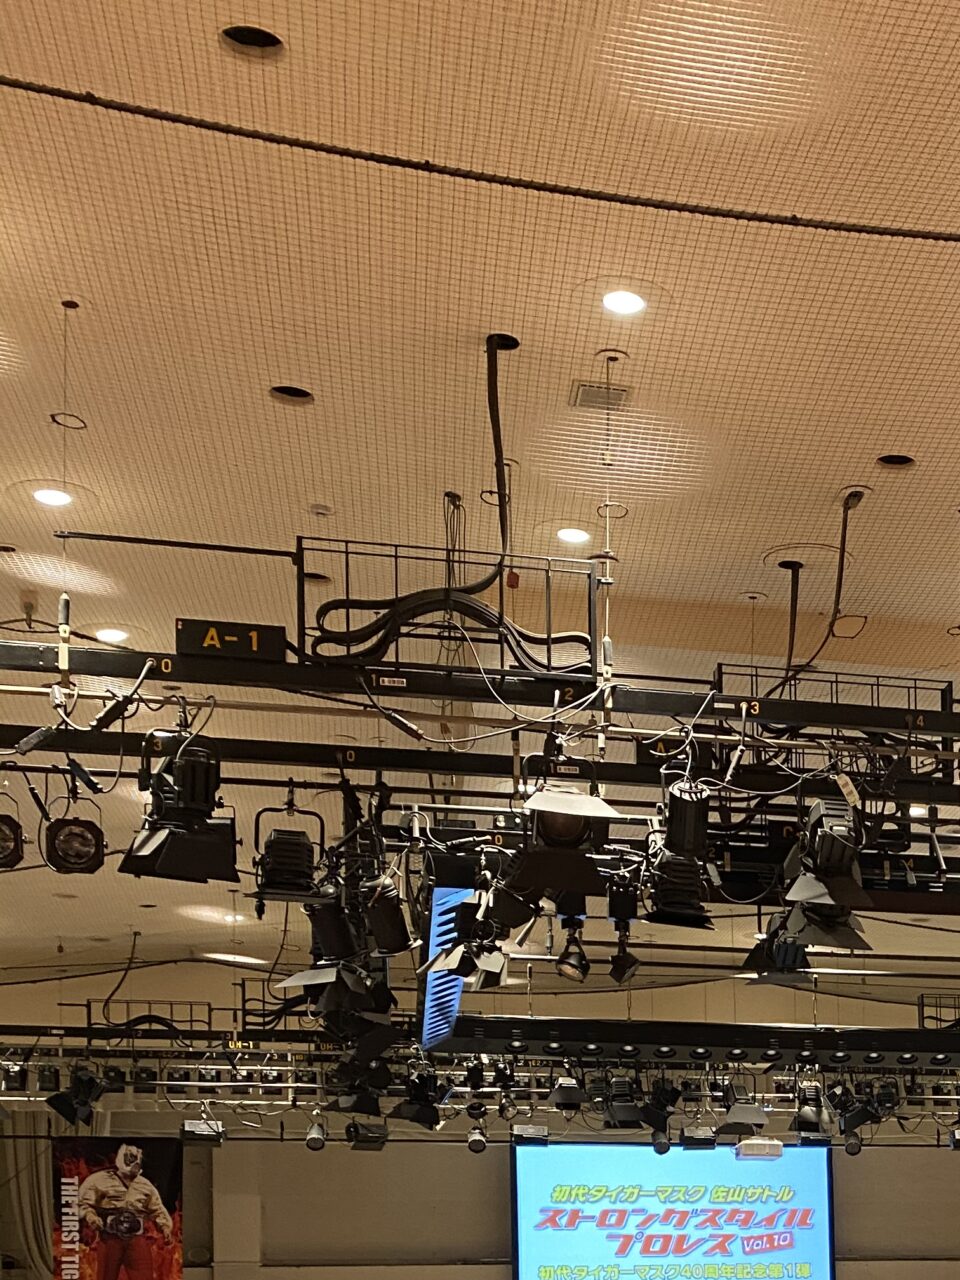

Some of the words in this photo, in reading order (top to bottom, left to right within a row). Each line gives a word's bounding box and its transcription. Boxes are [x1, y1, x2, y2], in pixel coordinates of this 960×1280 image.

[202, 627, 259, 652] A-1
[750, 701, 760, 715] 3
[61, 1175, 79, 1204] THE
[552, 1185, 705, 1204] 初代タイガーマスク
[710, 1185, 795, 1204] 佐山サトル
[61, 1206, 80, 1251] FIRST
[534, 1207, 815, 1230] ストロングスタイル
[605, 1231, 738, 1258] プロレス
[743, 1233, 791, 1251] Vol.10
